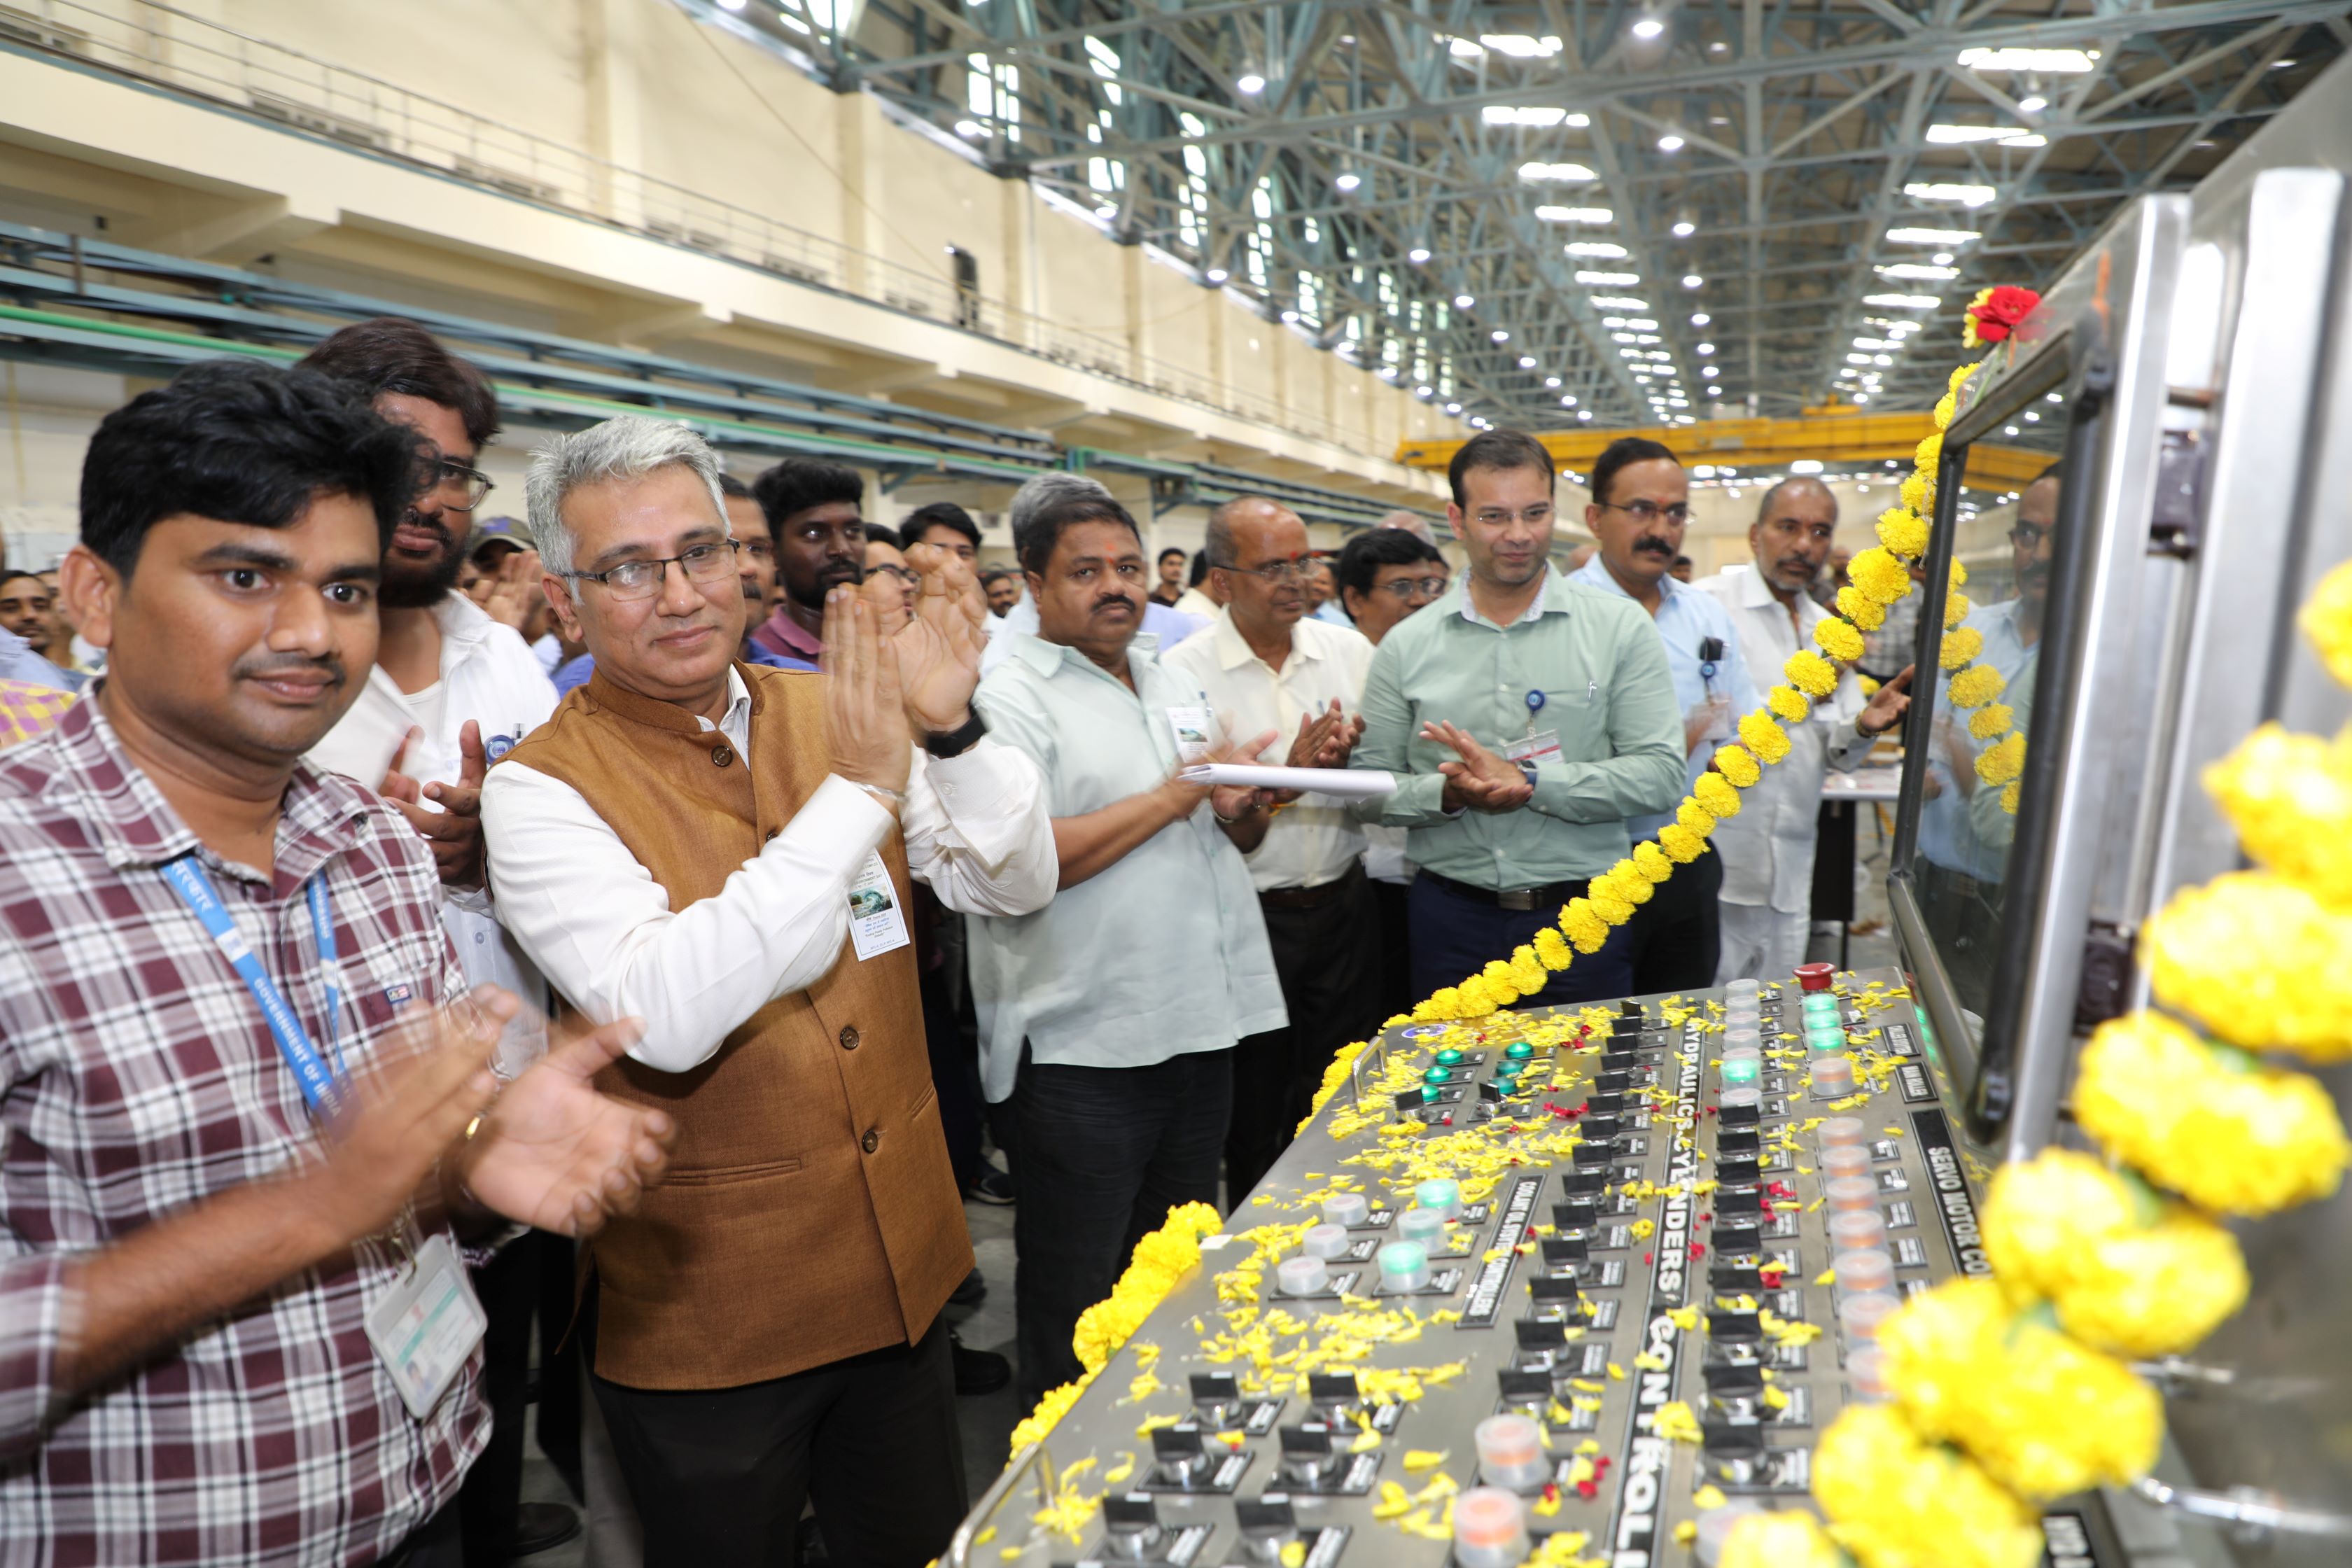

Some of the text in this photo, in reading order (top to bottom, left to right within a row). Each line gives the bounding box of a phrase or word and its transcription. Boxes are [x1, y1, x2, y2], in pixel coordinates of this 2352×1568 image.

[254, 977, 342, 1118] GOVERNMENT OF INDIA
[1674, 1021, 1701, 1131] HYDRAULICS
[1504, 1211, 1526, 1224] OIL
[1510, 1181, 1537, 1212] COOLANT
[1658, 1135, 1692, 1292] CYLNDERS
[1928, 1146, 1994, 1280] SERVO MOTOR CO
[1469, 1257, 1509, 1317] CONTROLLERS
